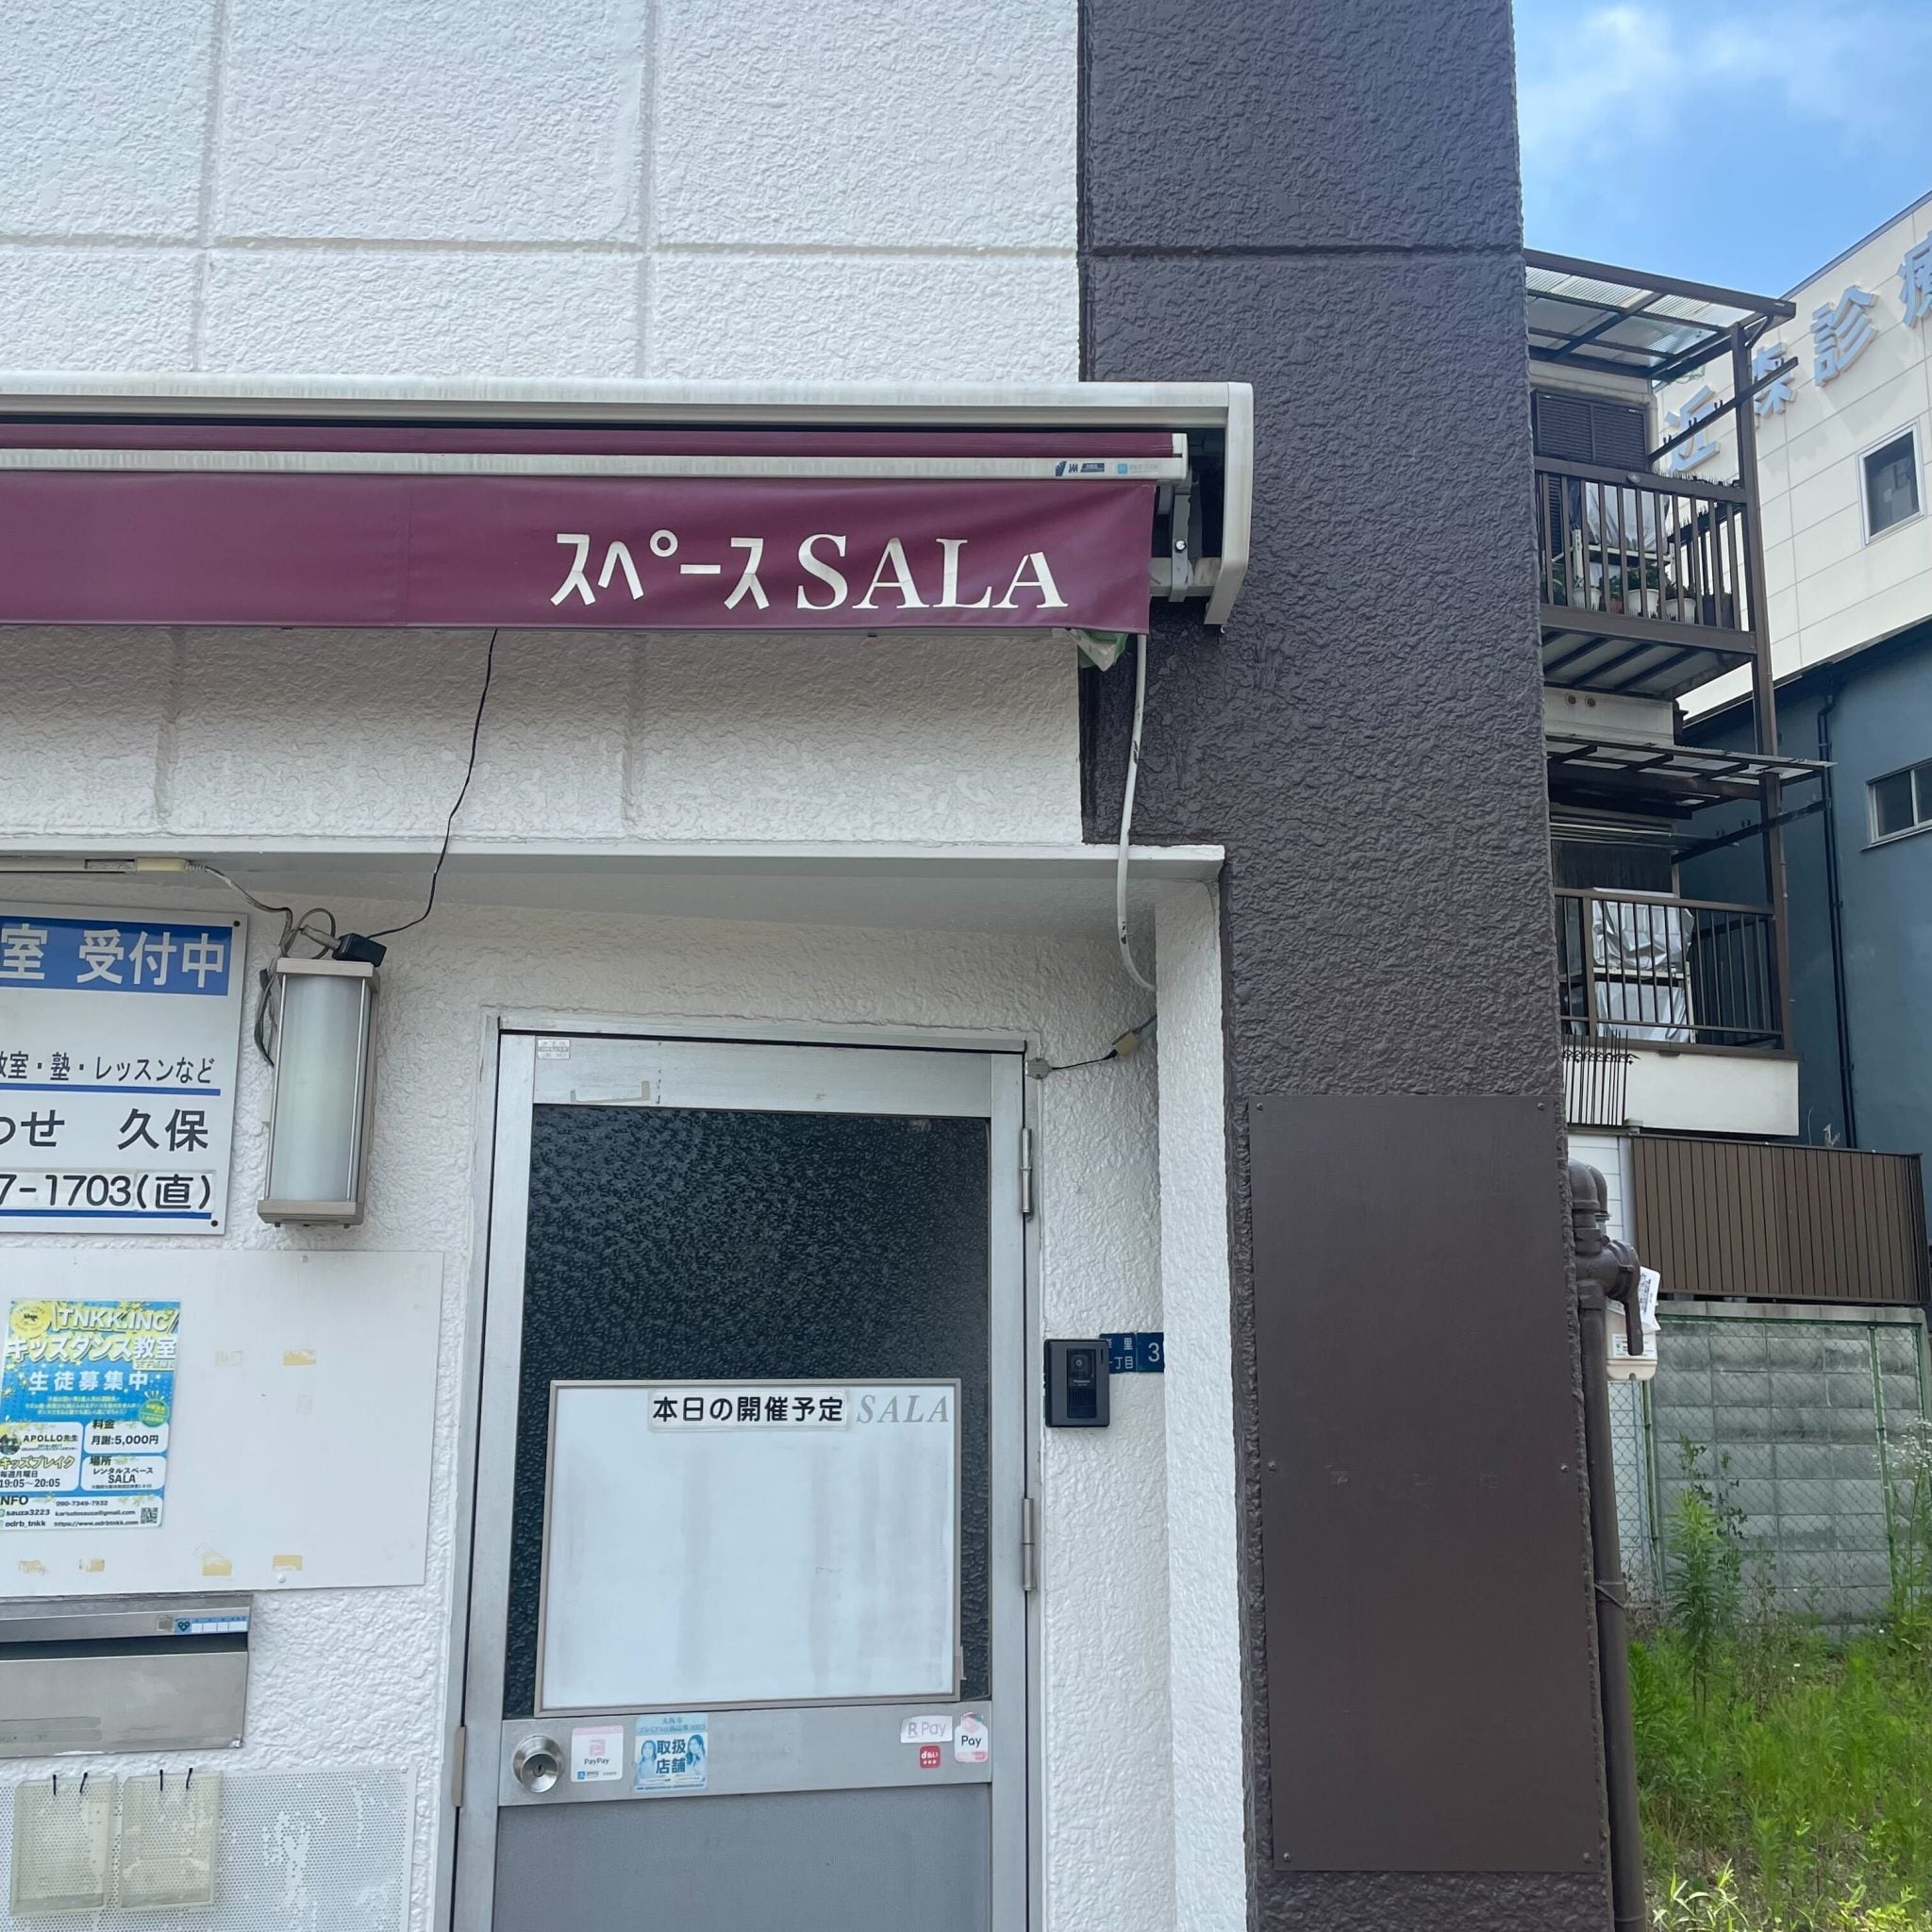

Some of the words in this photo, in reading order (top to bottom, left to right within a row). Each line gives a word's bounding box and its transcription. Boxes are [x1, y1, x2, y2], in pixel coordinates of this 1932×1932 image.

[550, 529, 770, 610] スペース
[797, 534, 1068, 610] SALA
[76, 928, 225, 989] 受付中
[0, 1051, 216, 1084] 室・塾・レッスンなど
[117, 1108, 209, 1152] 久保
[7, 1334, 176, 1362] キッズダンス教室
[1148, 1342, 1160, 1362] 3
[28, 1371, 148, 1391] 生徒募集中
[652, 1396, 843, 1423] 本日の開催予定
[857, 1394, 950, 1424] SALA
[92, 1419, 115, 1429] 料金
[90, 1456, 111, 1466] 場所
[108, 1474, 136, 1484] SALA
[921, 1722, 947, 1738] Pay
[656, 1739, 687, 1756] 取扱
[961, 1735, 982, 1748] Pay
[583, 1757, 610, 1766] PayPay
[656, 1757, 687, 1774] 店舗
